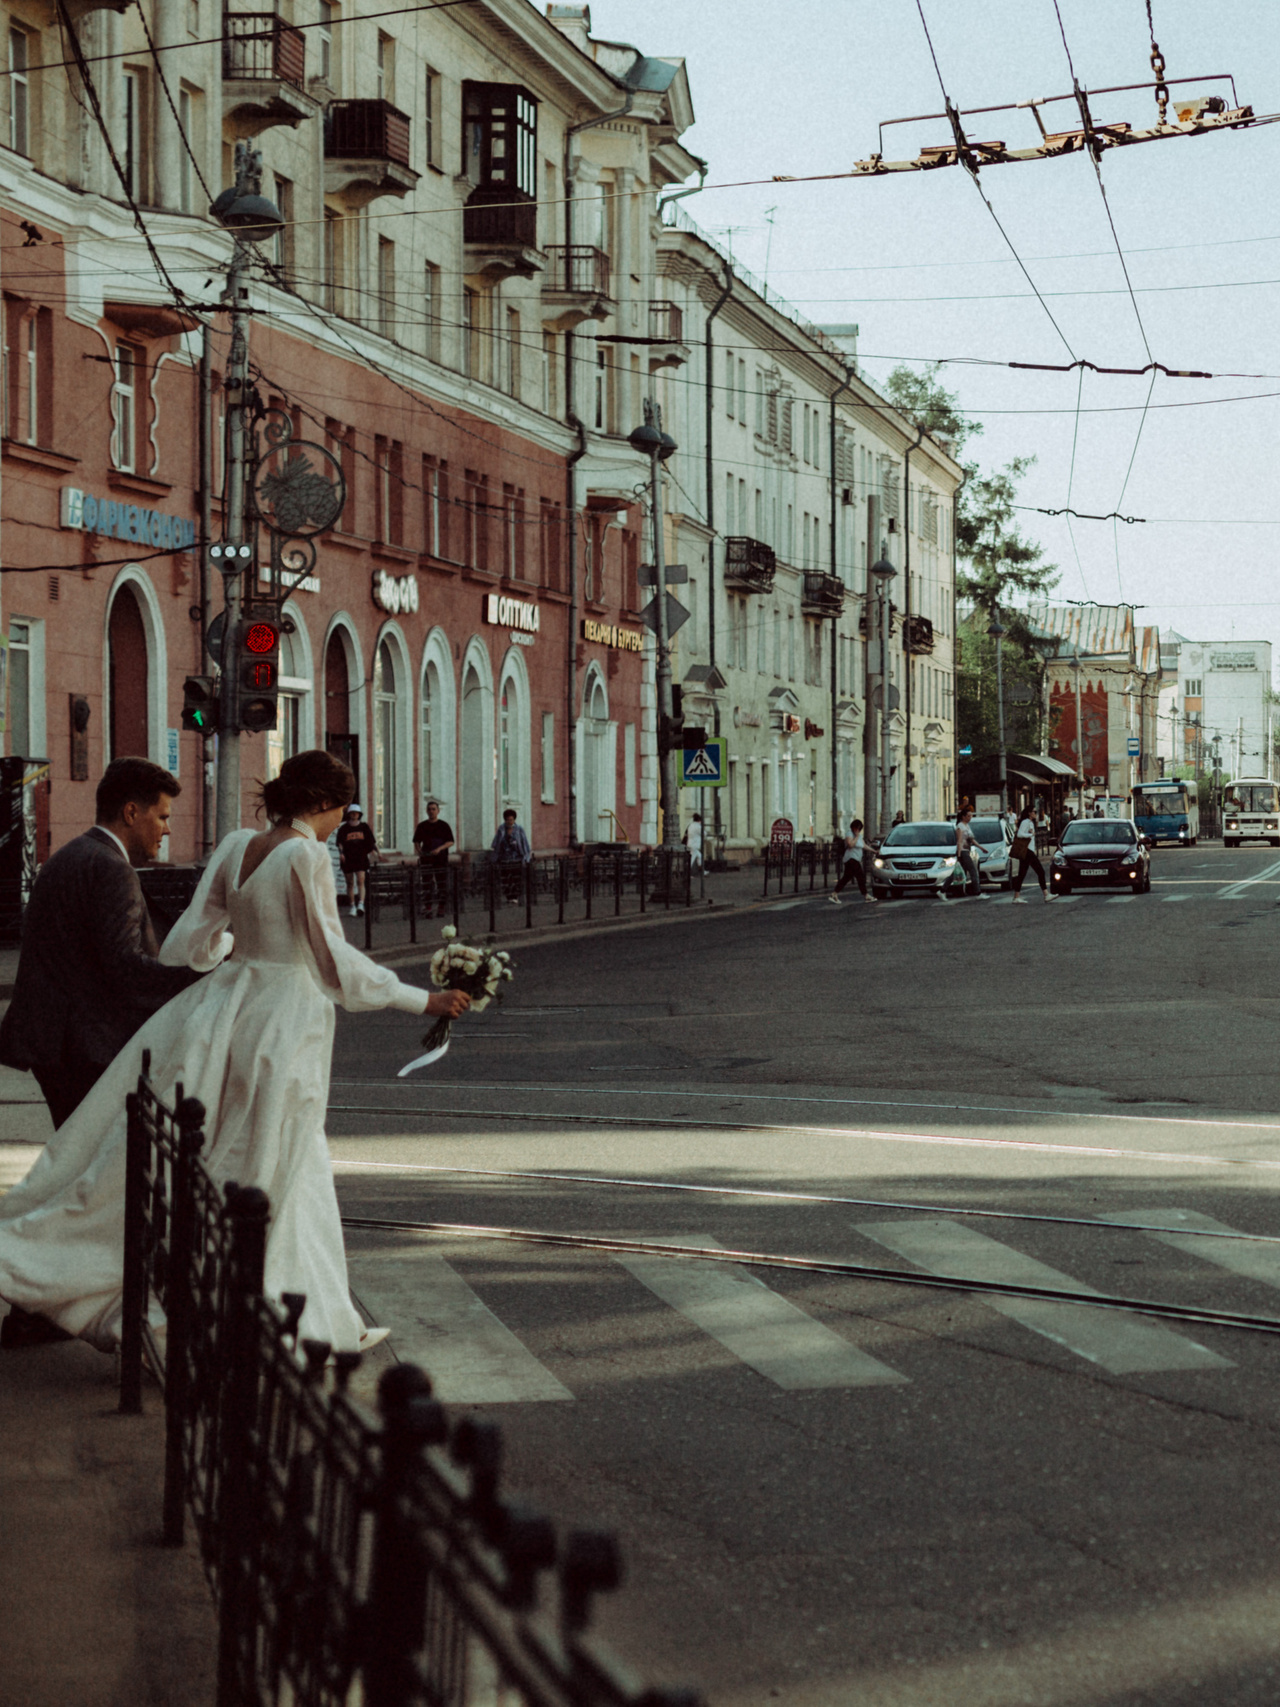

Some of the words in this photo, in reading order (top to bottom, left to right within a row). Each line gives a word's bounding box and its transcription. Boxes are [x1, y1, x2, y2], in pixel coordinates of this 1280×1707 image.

[83, 493, 194, 554] ФАРМЭКОНОМ
[499, 596, 539, 632] ОПТИКА
[585, 620, 611, 645] ПЕКАРНЯ
[773, 834, 790, 843] 199
